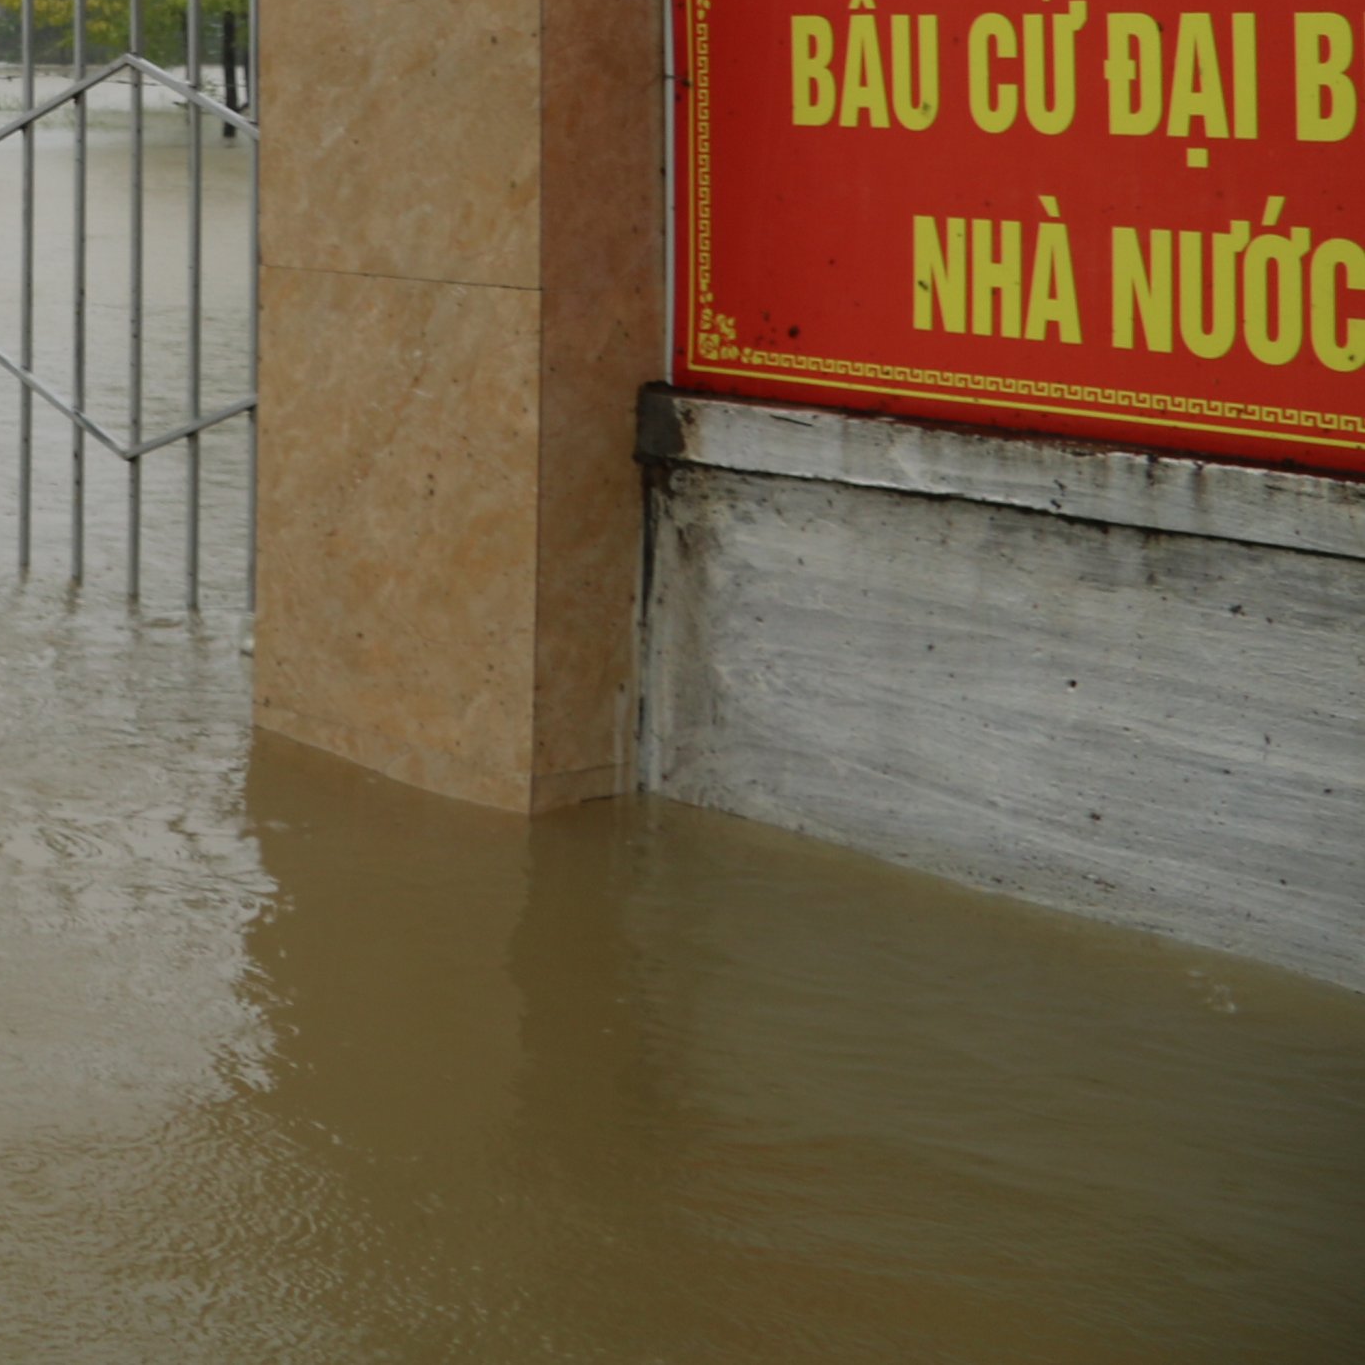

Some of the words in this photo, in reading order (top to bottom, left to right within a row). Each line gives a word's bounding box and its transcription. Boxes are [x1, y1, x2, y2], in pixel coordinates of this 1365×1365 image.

[1104, 11, 1259, 169] ĐẠI
[1293, 11, 1365, 143] B
[912, 195, 1082, 345] NHÀ
[1111, 195, 1365, 372] NƯỚC
